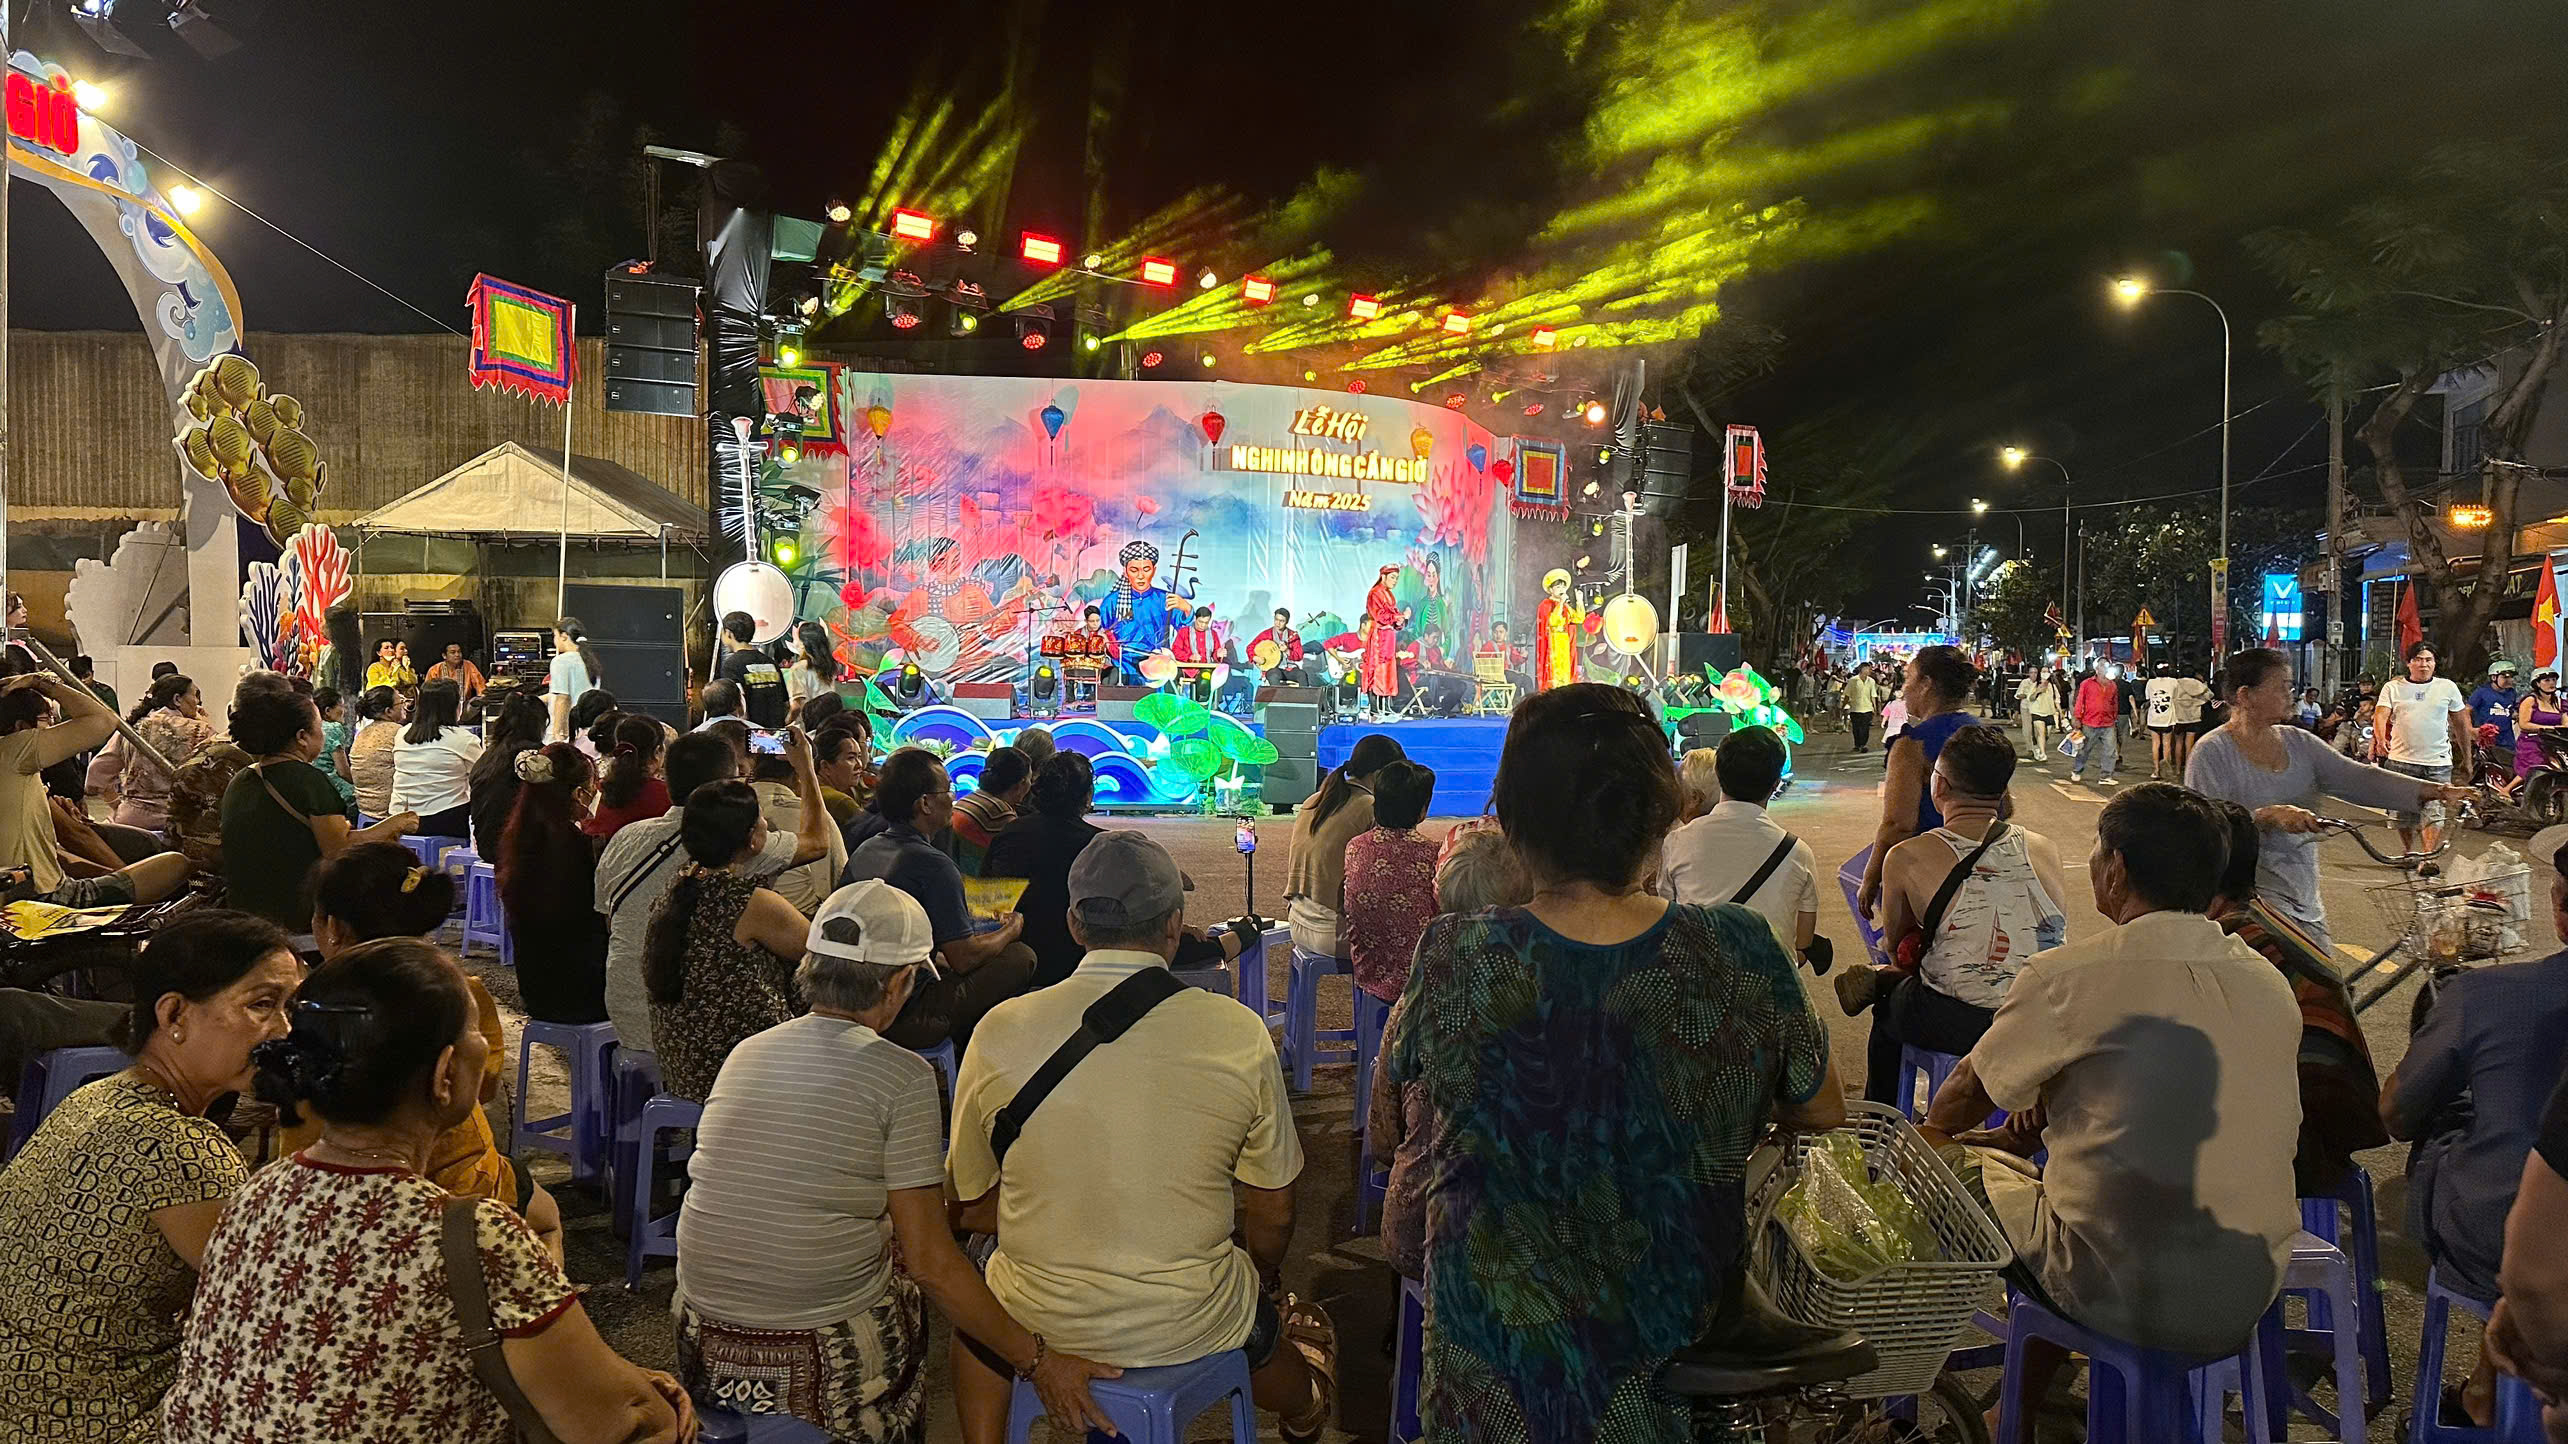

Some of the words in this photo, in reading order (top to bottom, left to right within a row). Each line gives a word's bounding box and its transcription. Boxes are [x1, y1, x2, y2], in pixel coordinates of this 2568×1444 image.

[1324, 411, 1369, 444] Hội
[1231, 444, 1309, 474] NGHINH
[1310, 447, 1352, 478] ÔNG
[1330, 491, 1372, 511] 2025
